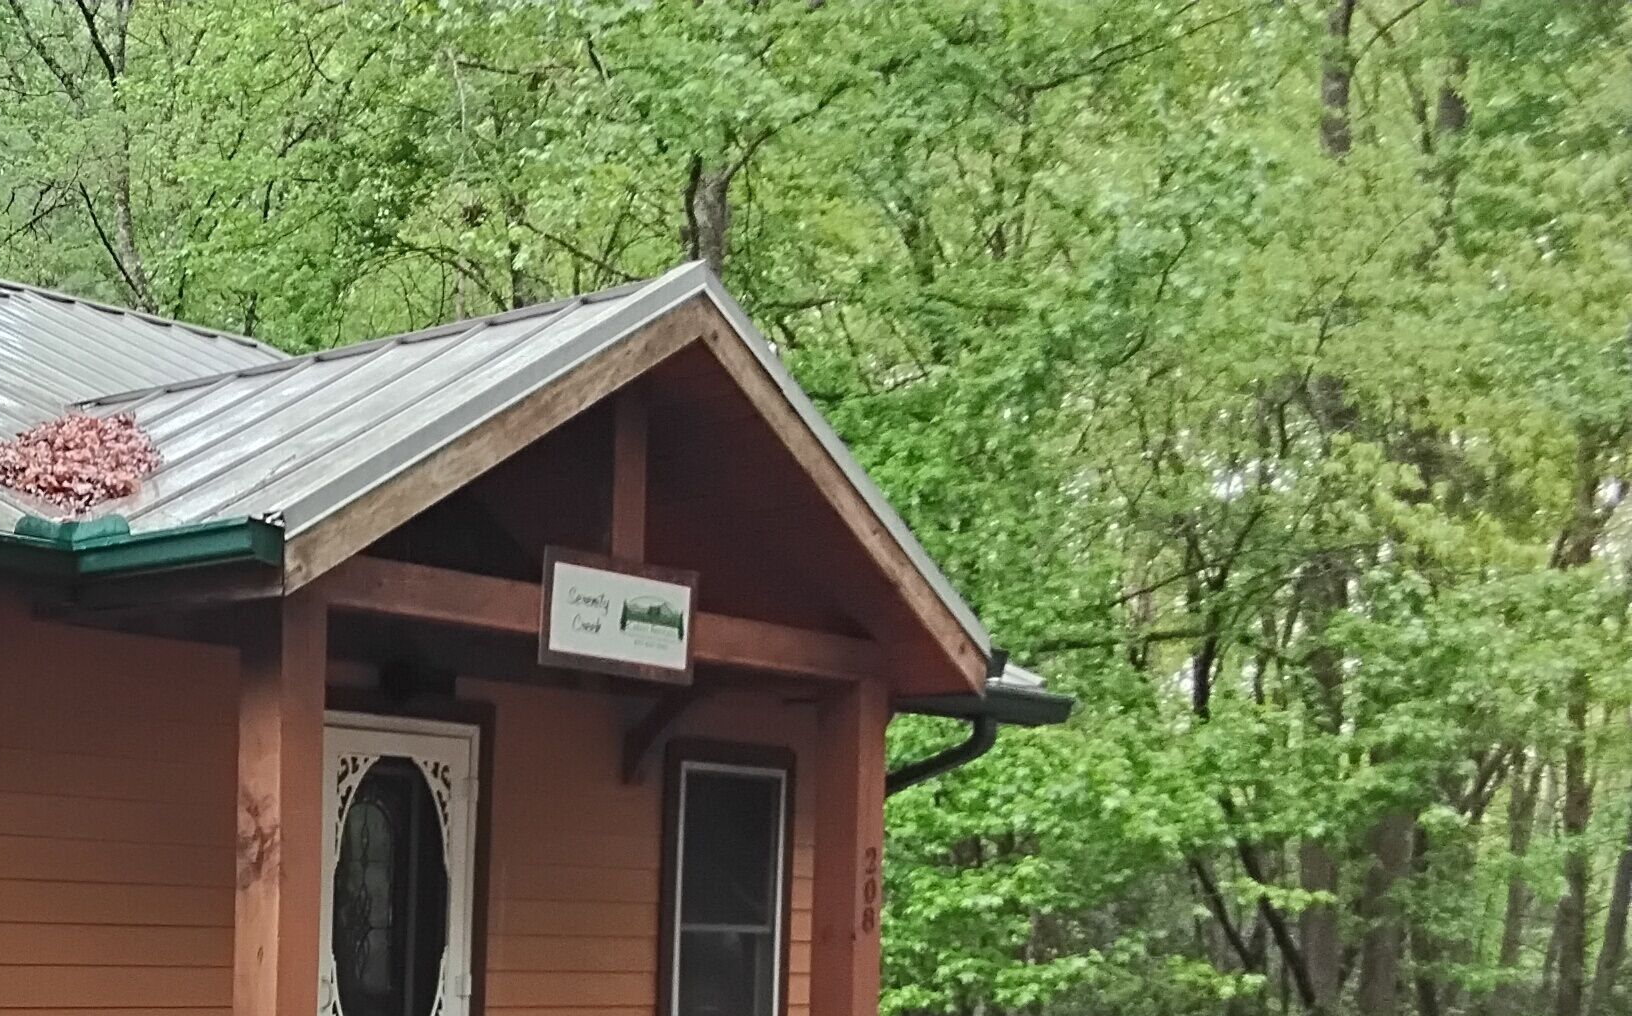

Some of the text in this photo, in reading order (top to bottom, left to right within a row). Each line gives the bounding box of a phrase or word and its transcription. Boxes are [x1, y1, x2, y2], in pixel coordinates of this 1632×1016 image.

[568, 585, 610, 616] Serenity
[572, 613, 602, 634] Creek
[863, 847, 877, 934] 208
